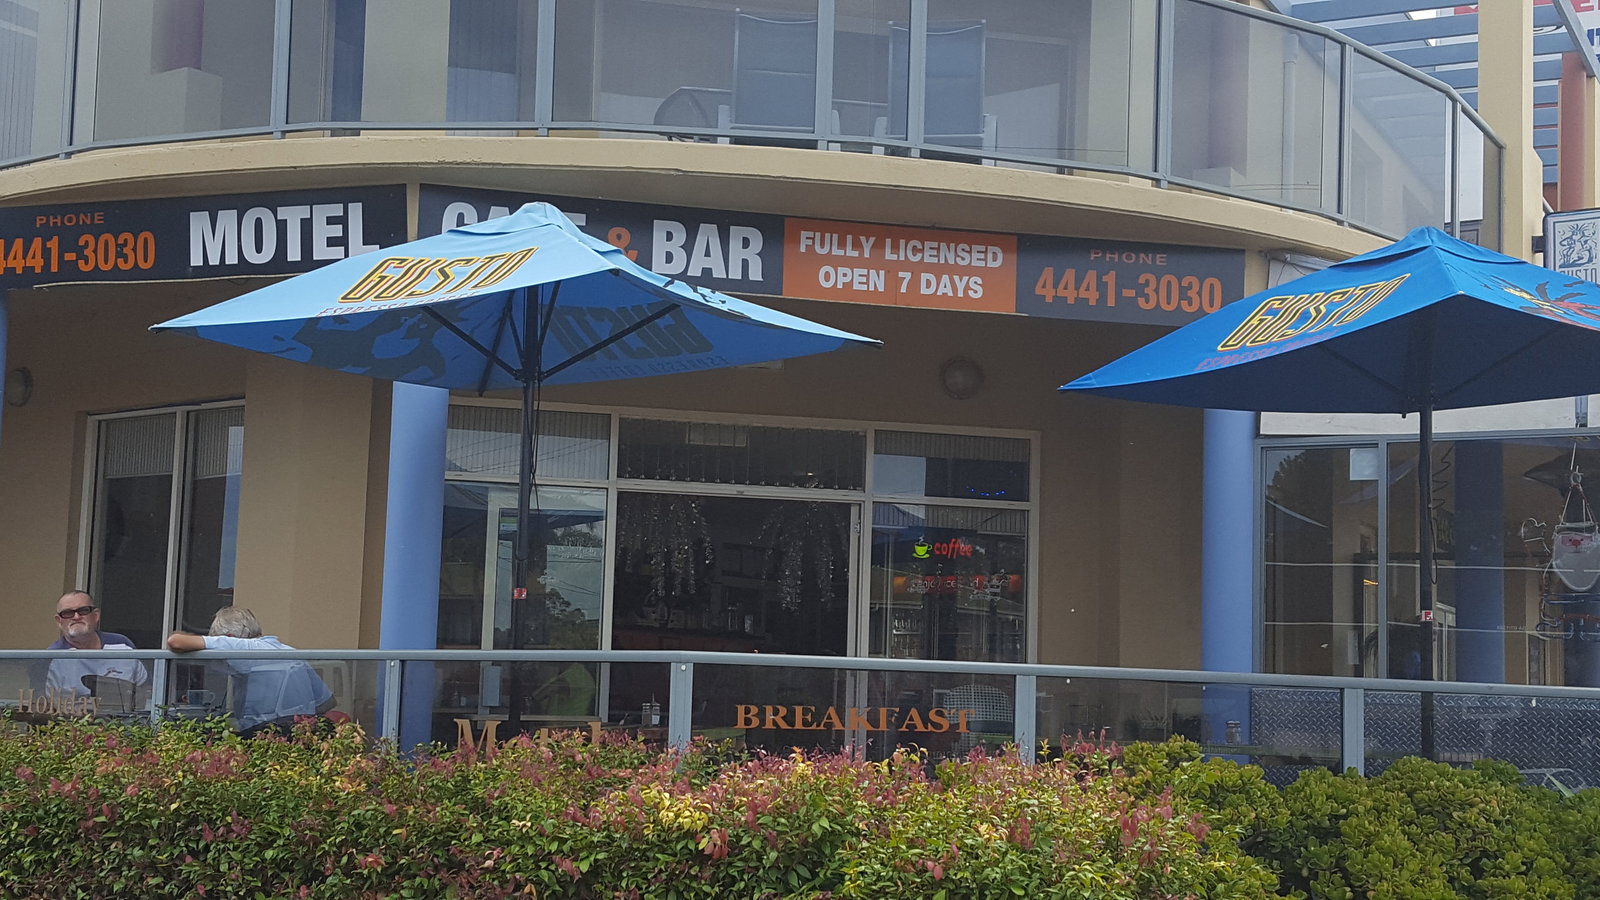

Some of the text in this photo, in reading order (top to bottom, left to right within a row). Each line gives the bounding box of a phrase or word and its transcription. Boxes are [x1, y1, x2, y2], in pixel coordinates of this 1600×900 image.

[36, 212, 105, 228] PHONE
[189, 202, 380, 267] MOTEL
[652, 219, 764, 282] BAR
[800, 230, 1004, 268] FULLY LICENSED
[1090, 248, 1168, 266] PHONE
[338, 246, 540, 304] GUSTO
[818, 265, 984, 299] OPEN 7 DAYS
[1035, 266, 1223, 314] 4441-3030
[1217, 273, 1411, 352] GUSTO
[933, 538, 973, 560] coffee
[733, 704, 977, 734] BREAKFAST
